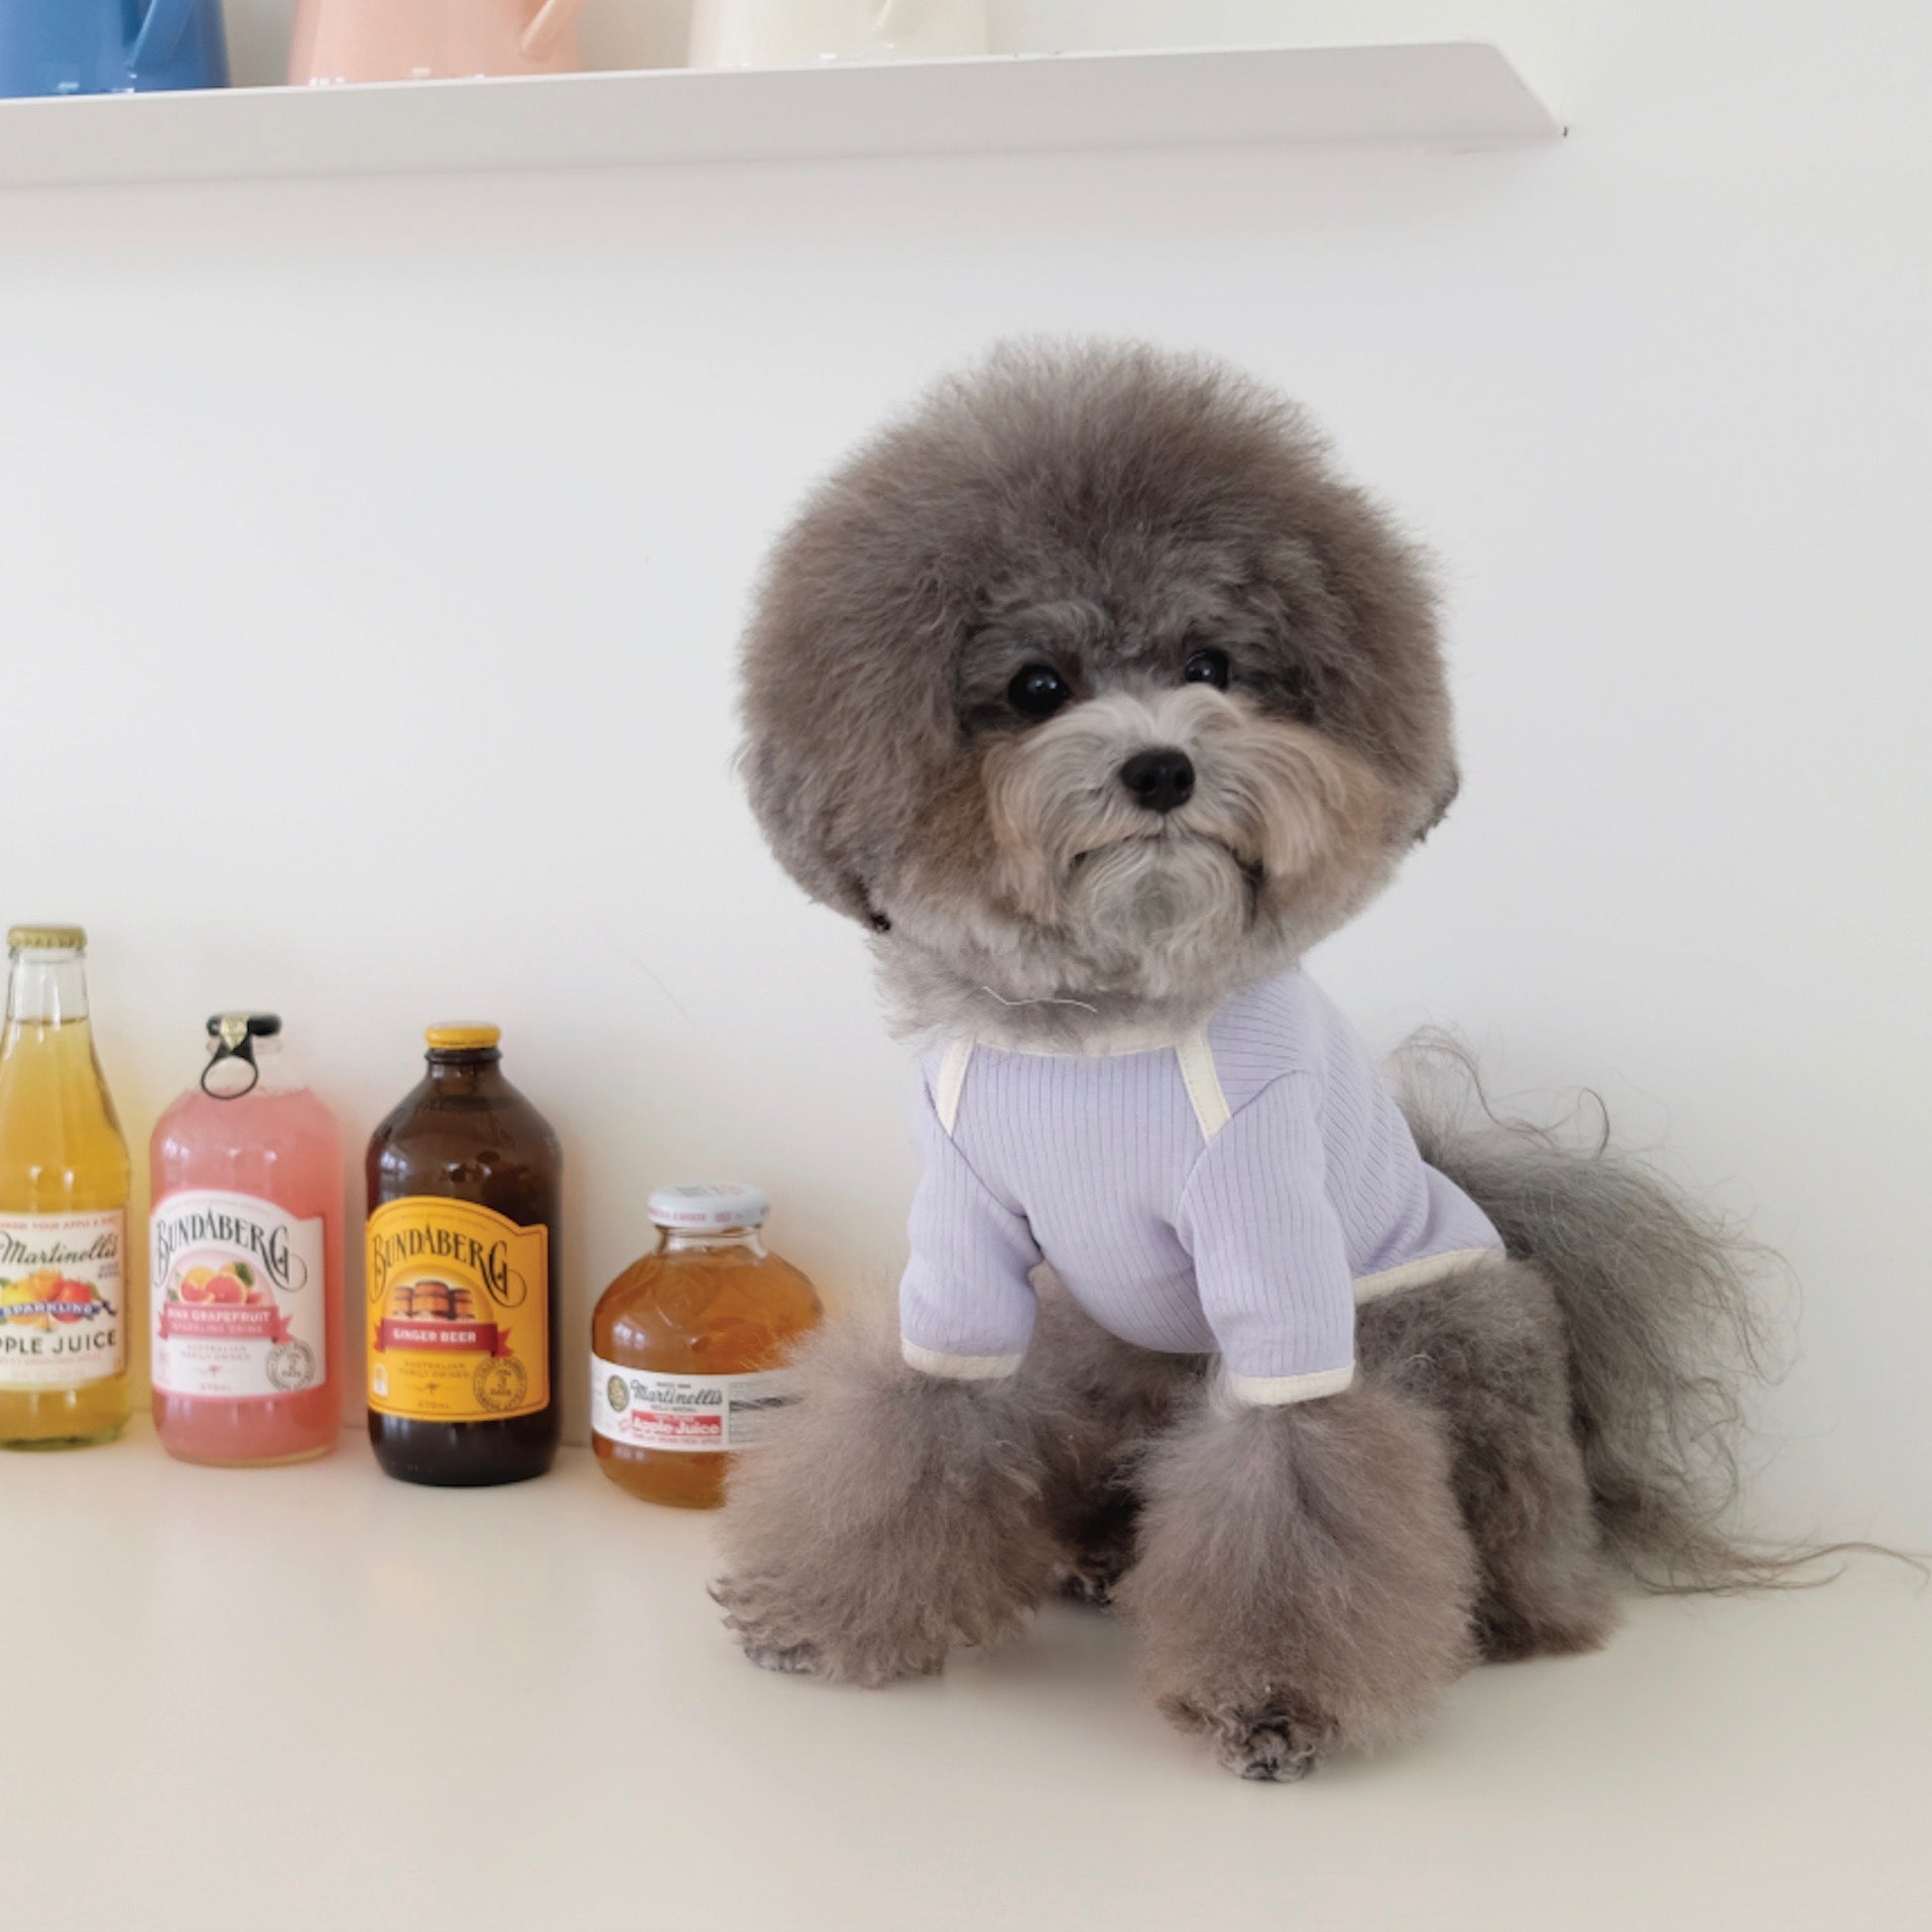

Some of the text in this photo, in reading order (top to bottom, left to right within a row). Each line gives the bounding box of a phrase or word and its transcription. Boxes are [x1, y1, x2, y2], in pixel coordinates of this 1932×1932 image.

[155, 1206, 307, 1292] BUNDABERG
[370, 1220, 528, 1308] BUNDABERG
[191, 1309, 271, 1323] GRAPEFRUIT
[53, 1329, 117, 1354] JUICE
[393, 1328, 476, 1343] GINGER BEER
[634, 1416, 673, 1435] Apple
[674, 1419, 722, 1435] Juice
